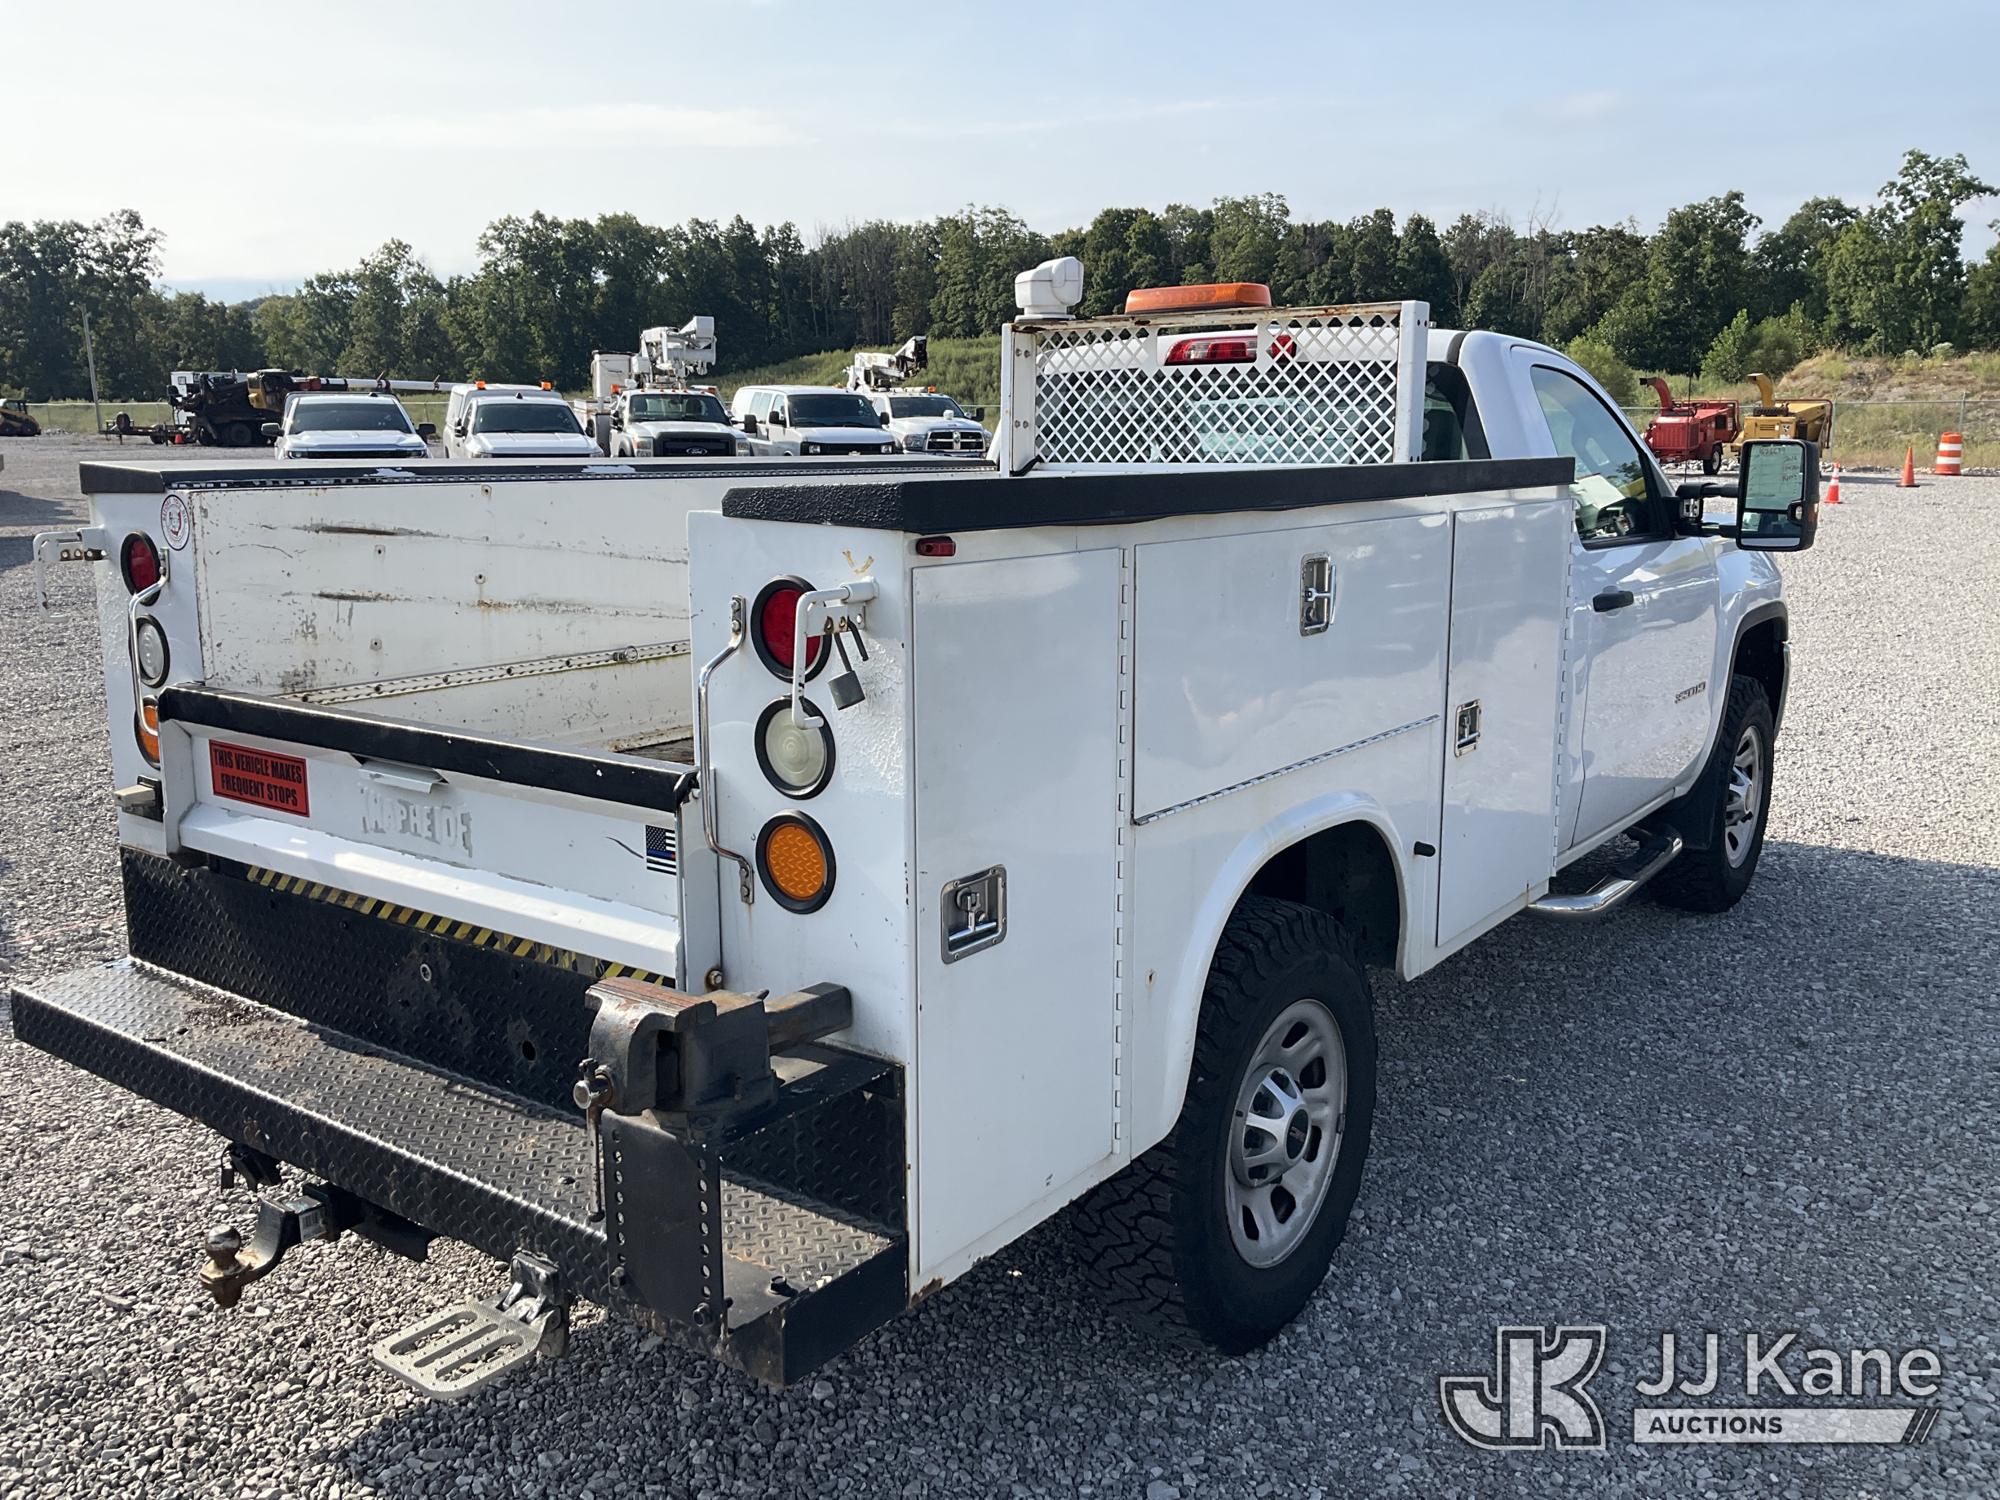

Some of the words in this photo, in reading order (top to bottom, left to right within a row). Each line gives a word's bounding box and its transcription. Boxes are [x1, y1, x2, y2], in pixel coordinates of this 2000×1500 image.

[213, 748, 234, 769] THIS
[234, 753, 270, 777] VEHICLE
[270, 760, 303, 784] MAKES
[220, 772, 265, 799] FREQUENT
[266, 782, 298, 807] STOPS
